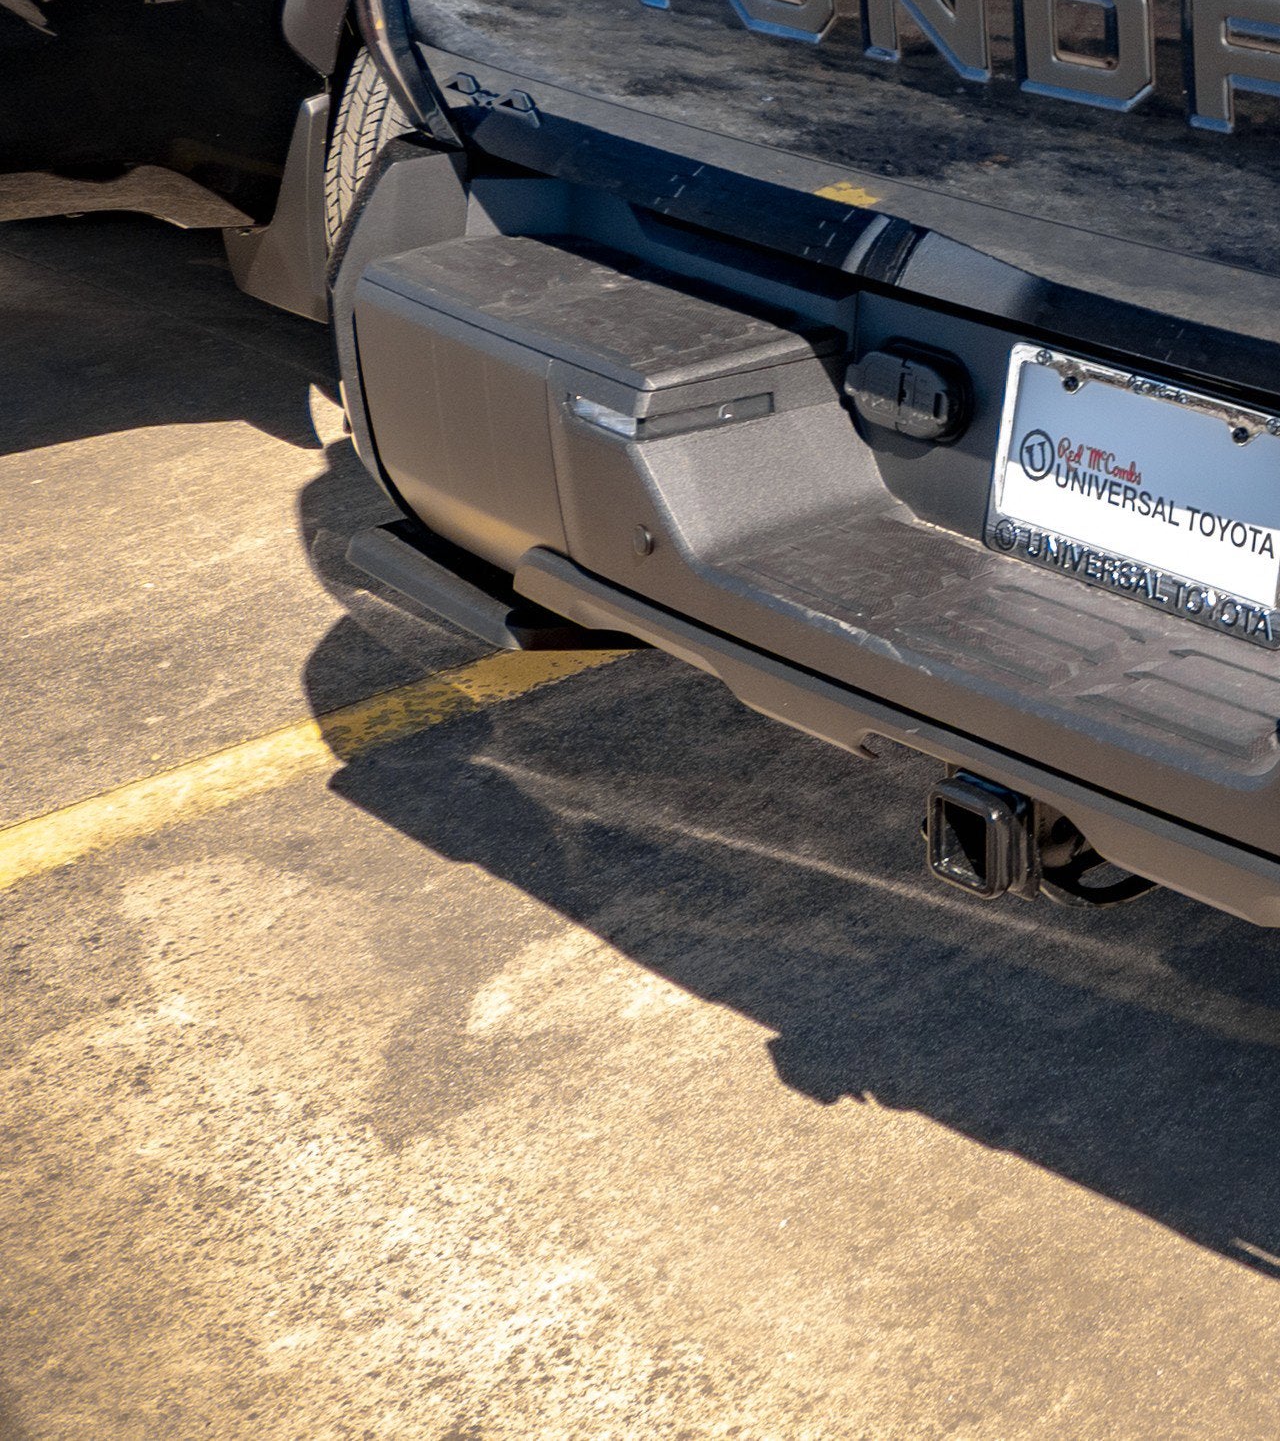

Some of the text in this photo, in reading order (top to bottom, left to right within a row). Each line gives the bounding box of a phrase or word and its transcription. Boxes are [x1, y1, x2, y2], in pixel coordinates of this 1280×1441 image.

[1057, 437, 1142, 486] Red McCombs
[1055, 463, 1275, 559] UNIVERSAL TOYOTA
[1027, 529, 1169, 603] UNIVERSAL
[1172, 577, 1274, 641] TOYOTA
